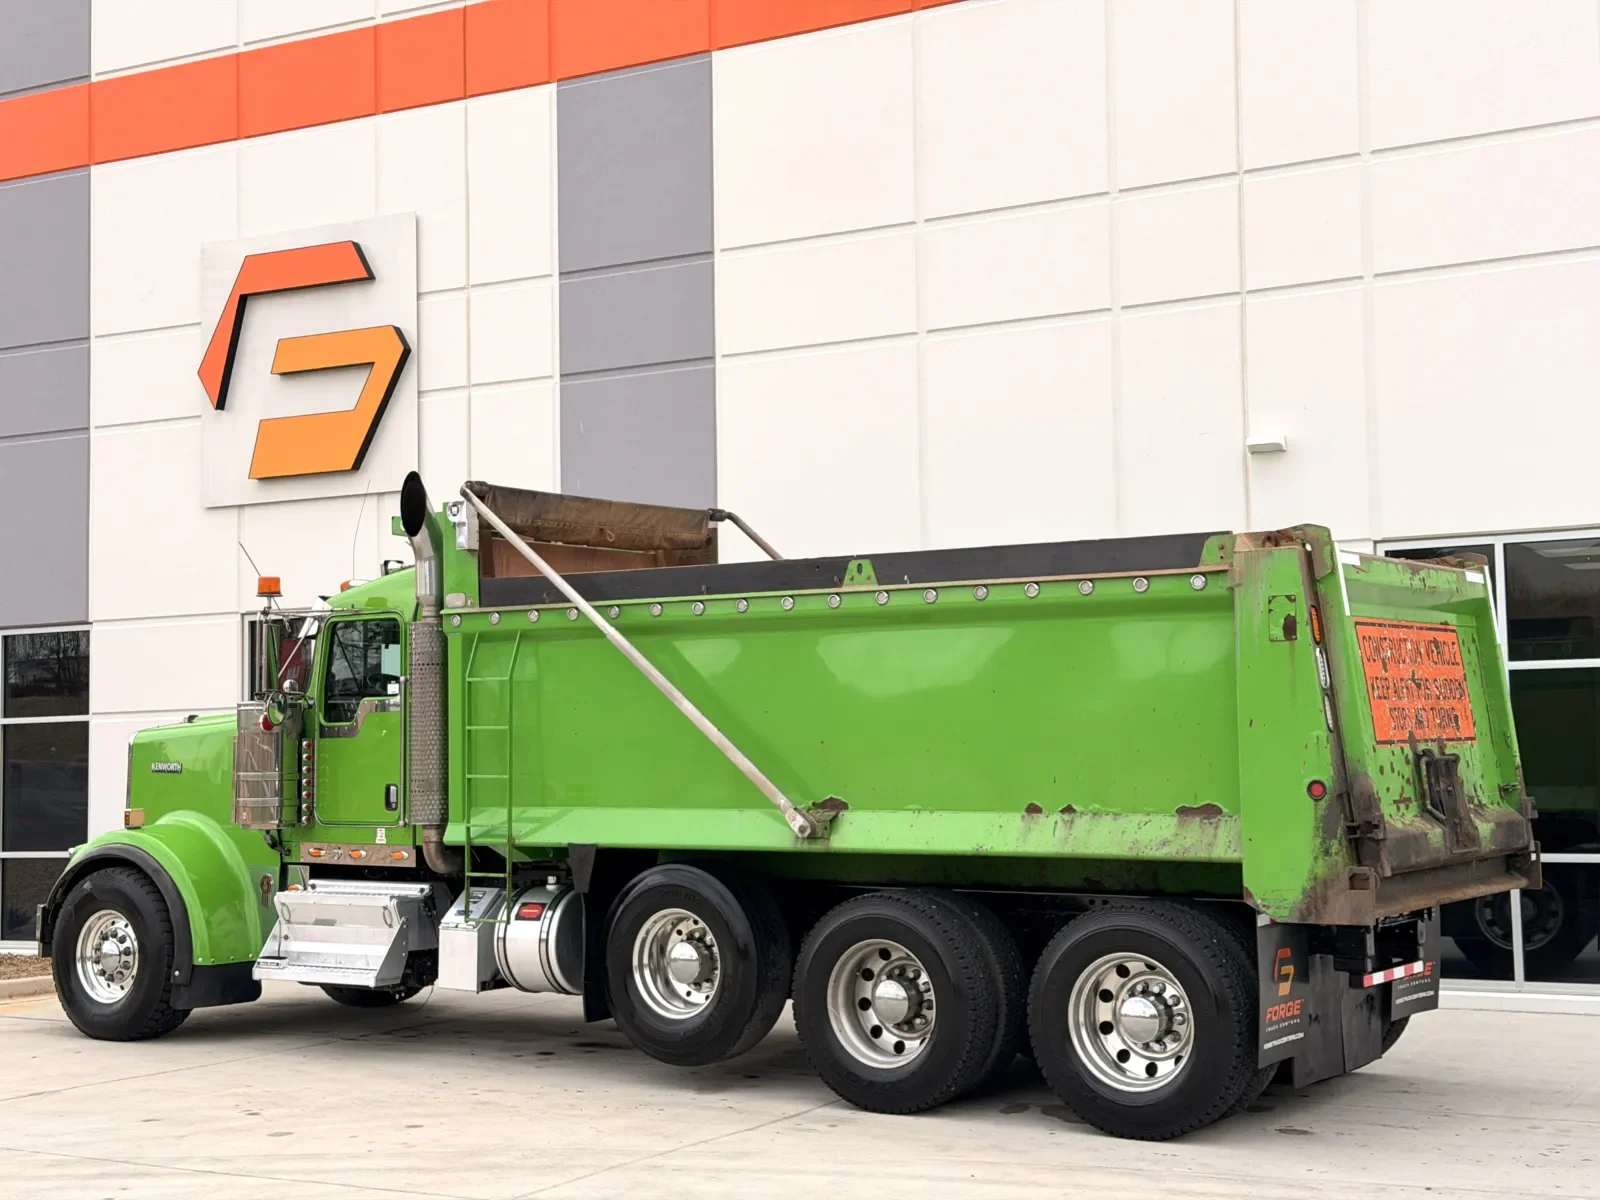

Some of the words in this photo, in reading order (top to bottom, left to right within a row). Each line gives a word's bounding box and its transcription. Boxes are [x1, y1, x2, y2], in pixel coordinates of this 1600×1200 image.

[1362, 635, 1424, 665] CONSTRUCTION
[1424, 639, 1460, 666] VEHICLE
[1370, 676, 1390, 700] KEEP
[1434, 678, 1466, 701] SUDDEN
[152, 762, 182, 772] KENWORTH
[1265, 999, 1302, 1024] FORGE
